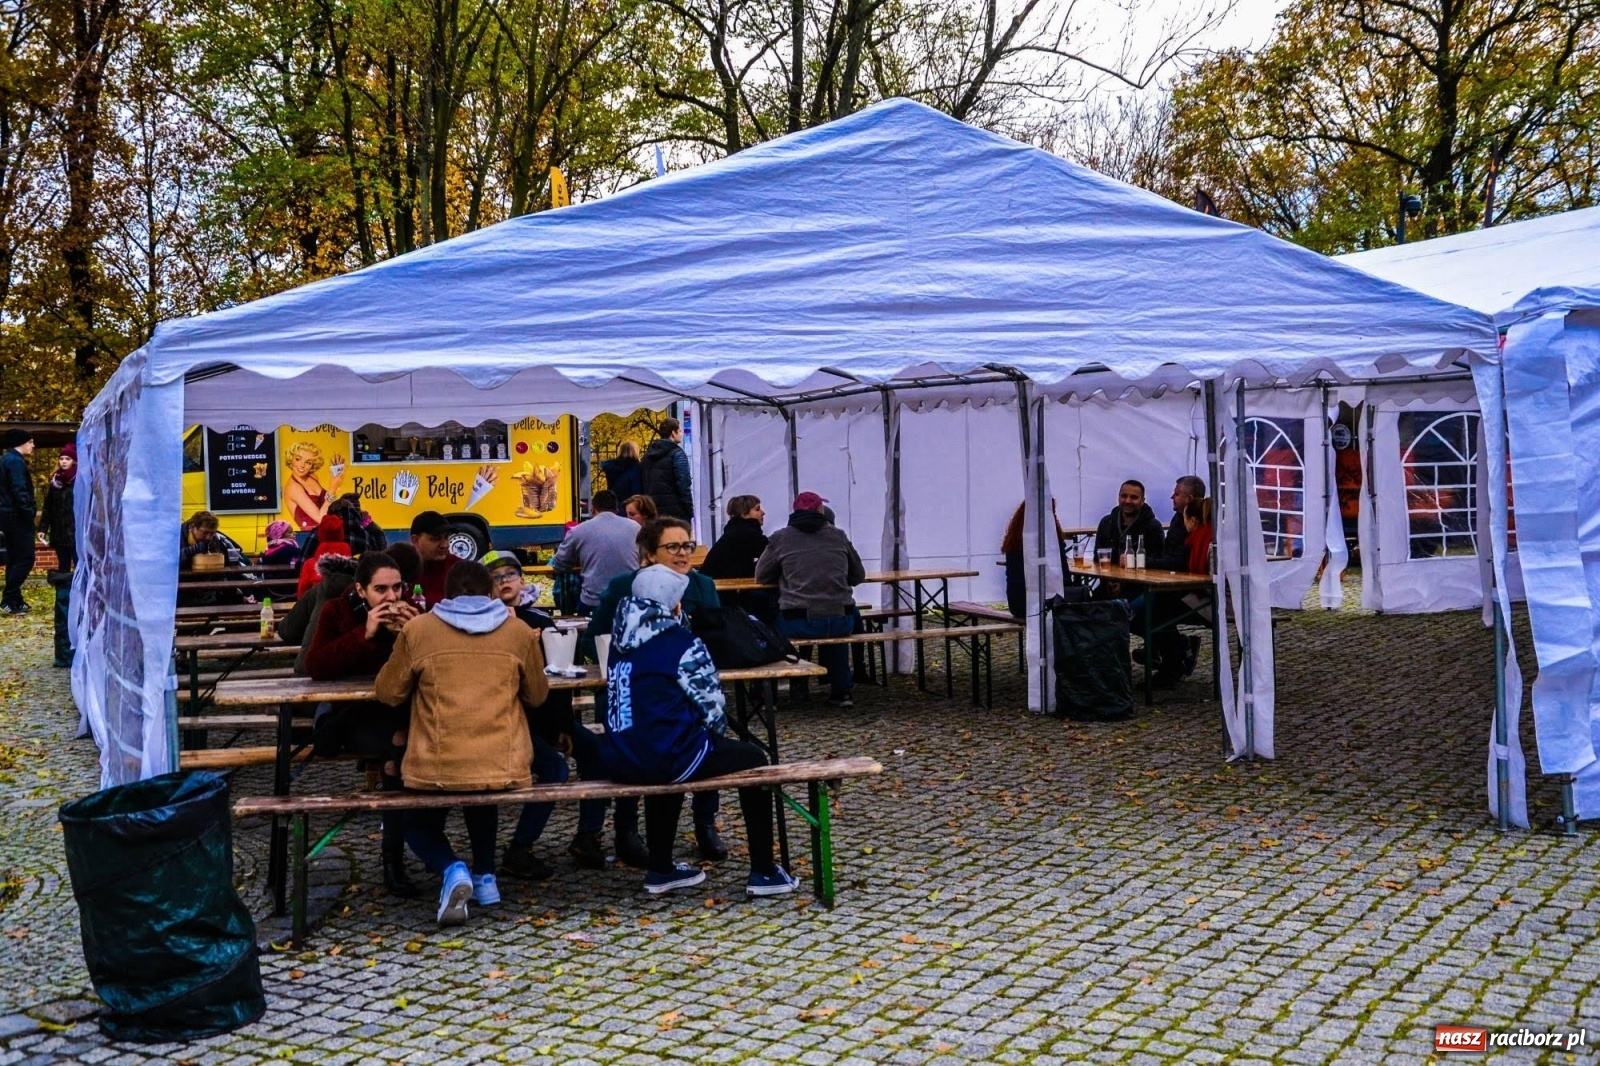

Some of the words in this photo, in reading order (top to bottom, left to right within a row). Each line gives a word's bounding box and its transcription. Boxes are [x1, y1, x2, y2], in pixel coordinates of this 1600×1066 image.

[352, 476, 387, 499] Belle
[426, 474, 465, 505] Belge
[619, 661, 633, 731] SCANIA
